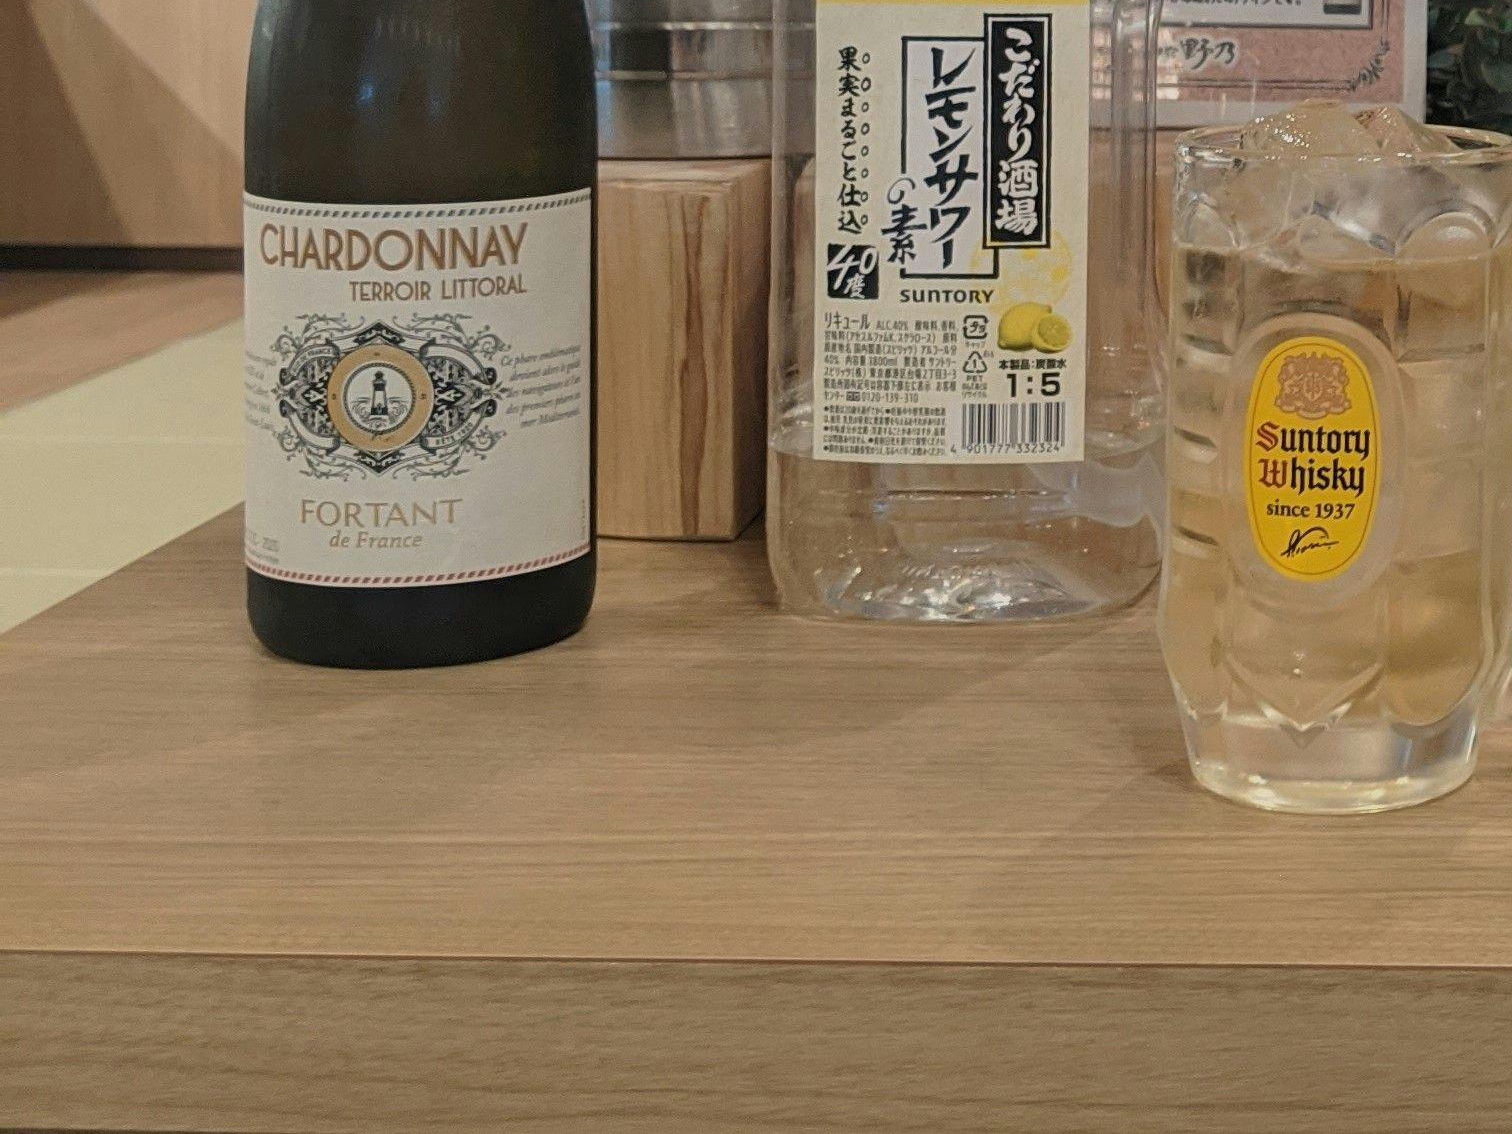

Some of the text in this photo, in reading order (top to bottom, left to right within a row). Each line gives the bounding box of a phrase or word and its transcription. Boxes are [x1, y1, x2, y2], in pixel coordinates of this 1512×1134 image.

[837, 46, 861, 234] 果実まるごと仕込
[995, 27, 1039, 236] こだわり酒場
[924, 47, 979, 269] レモンサワー
[881, 177, 927, 264] の素
[260, 223, 528, 271] CHARDONNAY
[350, 274, 527, 301] TERROIR LITTORAL
[900, 289, 995, 304] SUNTORY
[825, 311, 870, 329] リキュール
[1007, 372, 1060, 398] 1:5
[1256, 421, 1370, 461] Suntory
[1258, 458, 1365, 499] Whisky
[300, 498, 463, 528] FORTANT
[1266, 499, 1356, 520] since 1937
[329, 530, 422, 548] de France
